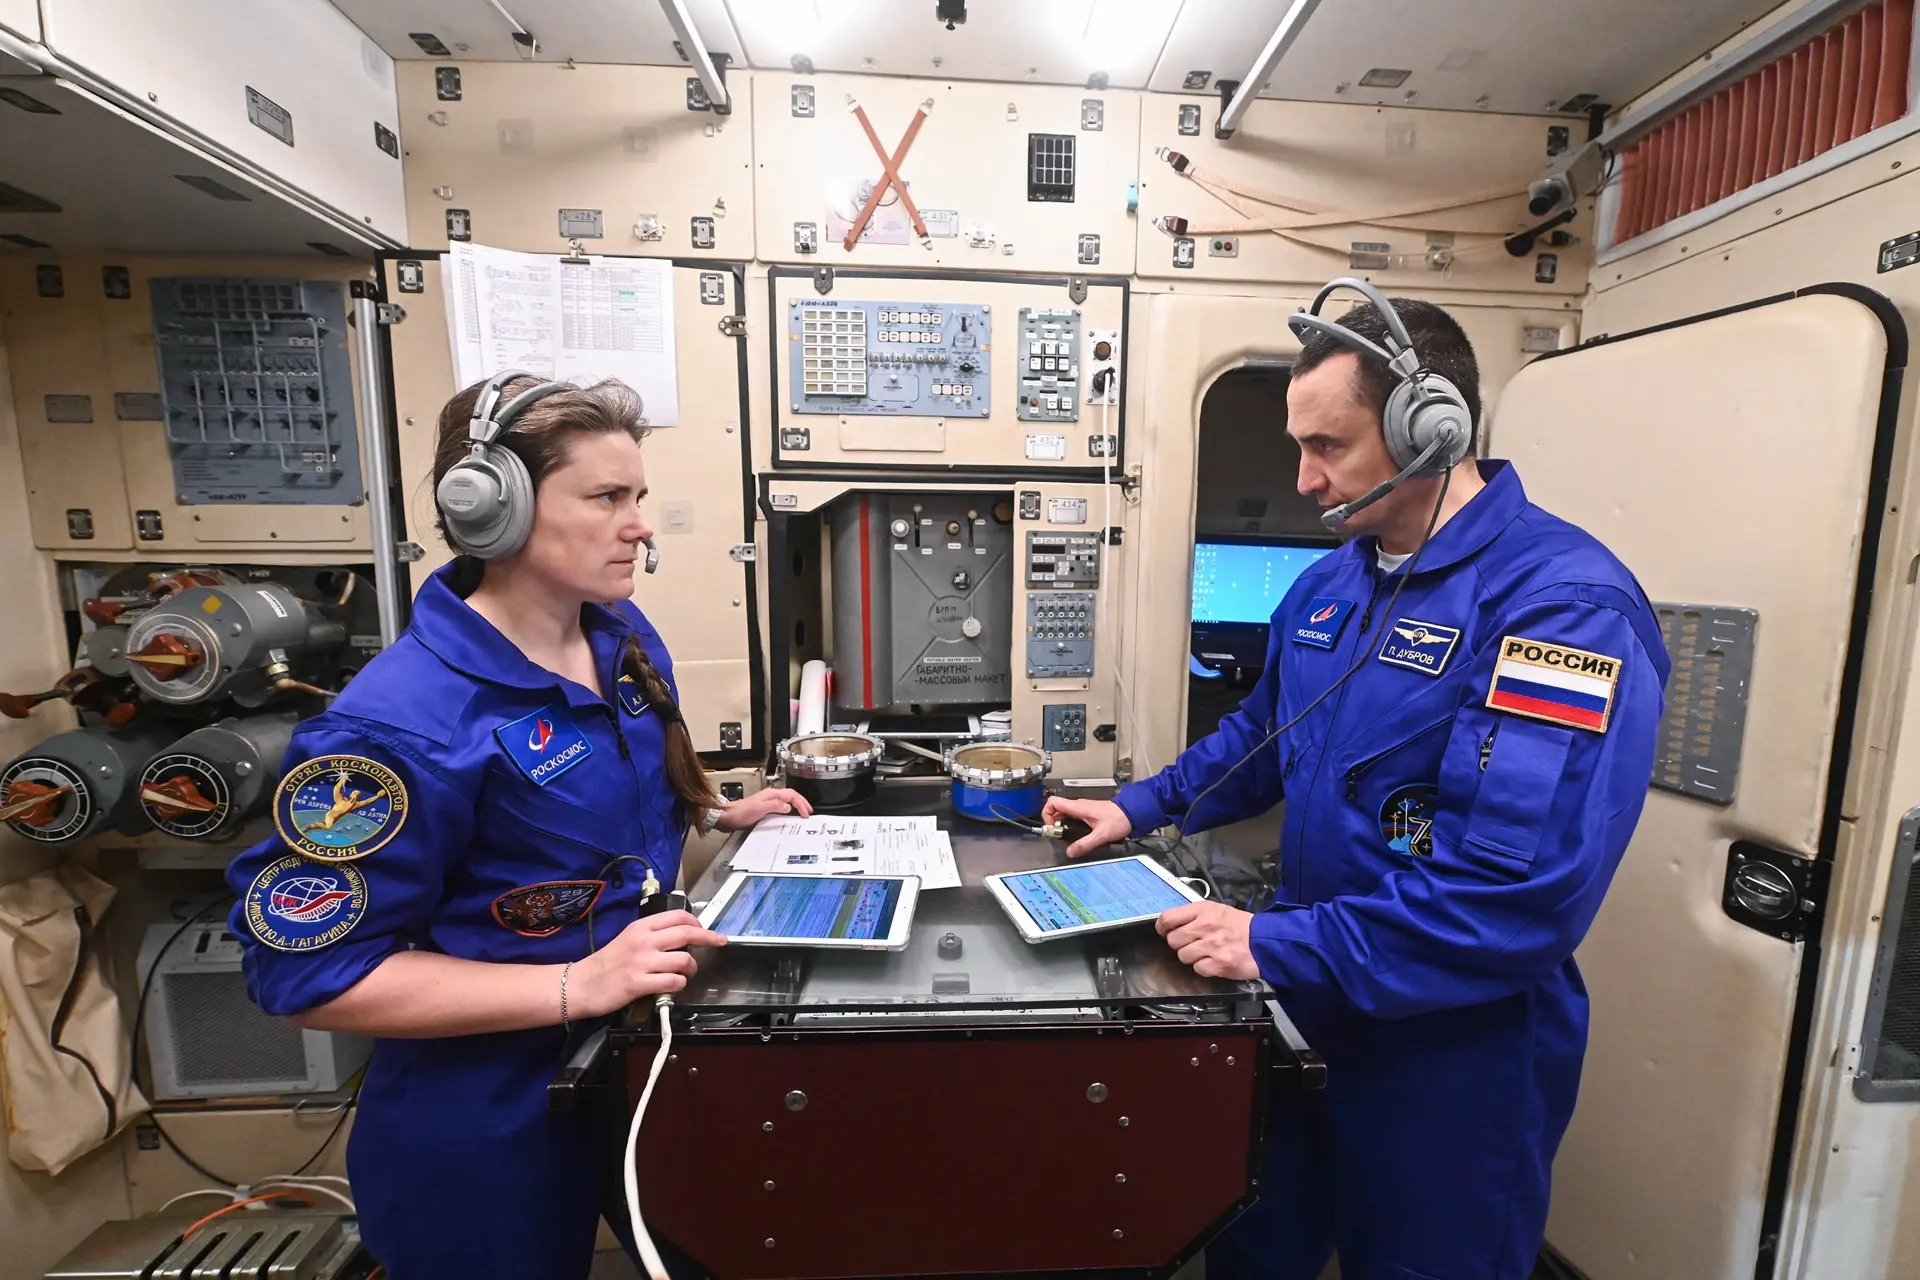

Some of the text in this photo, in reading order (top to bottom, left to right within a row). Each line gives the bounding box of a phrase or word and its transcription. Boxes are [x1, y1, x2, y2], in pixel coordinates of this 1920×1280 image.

[1039, 436, 1055, 445] 432
[1061, 500, 1077, 508] 434
[1396, 648, 1435, 665] ДУБРОВ
[1506, 641, 1614, 678] РОССИЯ
[916, 665, 973, 675] ГАБАРИТНО-
[974, 673, 1006, 684] МАКЕТ
[530, 740, 587, 780] РОСКОСМОС
[285, 759, 404, 811] ОТРЯД КОСМОНАВТОВ
[294, 798, 306, 806] PER
[307, 801, 332, 810] ASPERA
[296, 837, 358, 857] РОССИЯ
[257, 866, 280, 889] ЦЕНТР
[249, 901, 270, 934] ИМЕНИ
